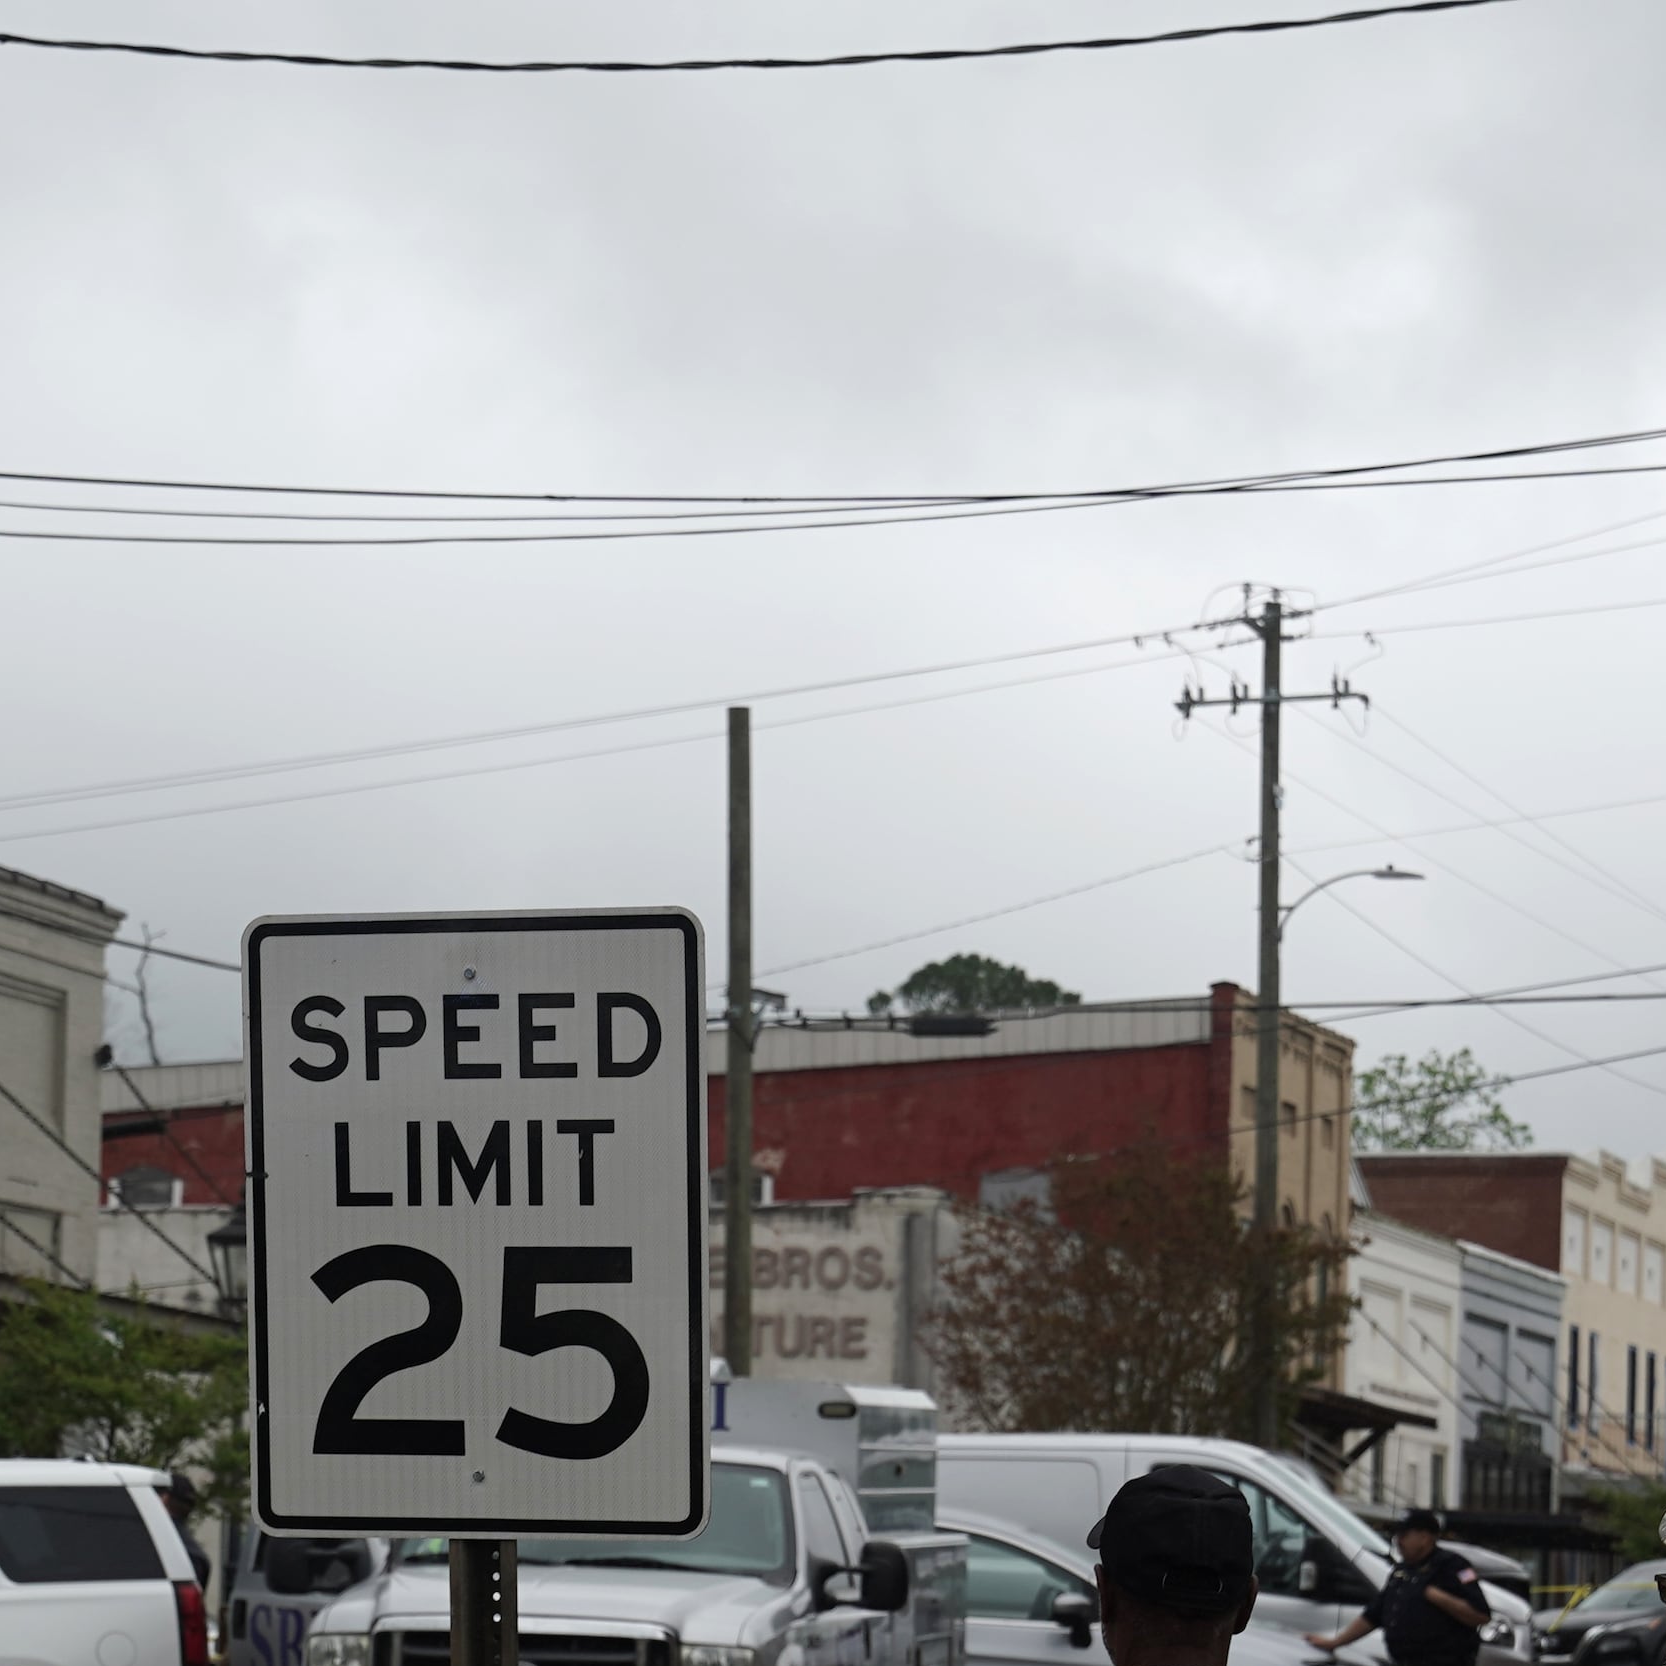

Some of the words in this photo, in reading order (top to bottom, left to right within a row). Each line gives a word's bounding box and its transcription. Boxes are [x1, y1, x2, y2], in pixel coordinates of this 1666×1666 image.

[289, 992, 662, 1082] SPEED
[335, 1119, 616, 1207] LIMIT
[751, 1246, 895, 1291] BROS.
[310, 1244, 650, 1460] 25
